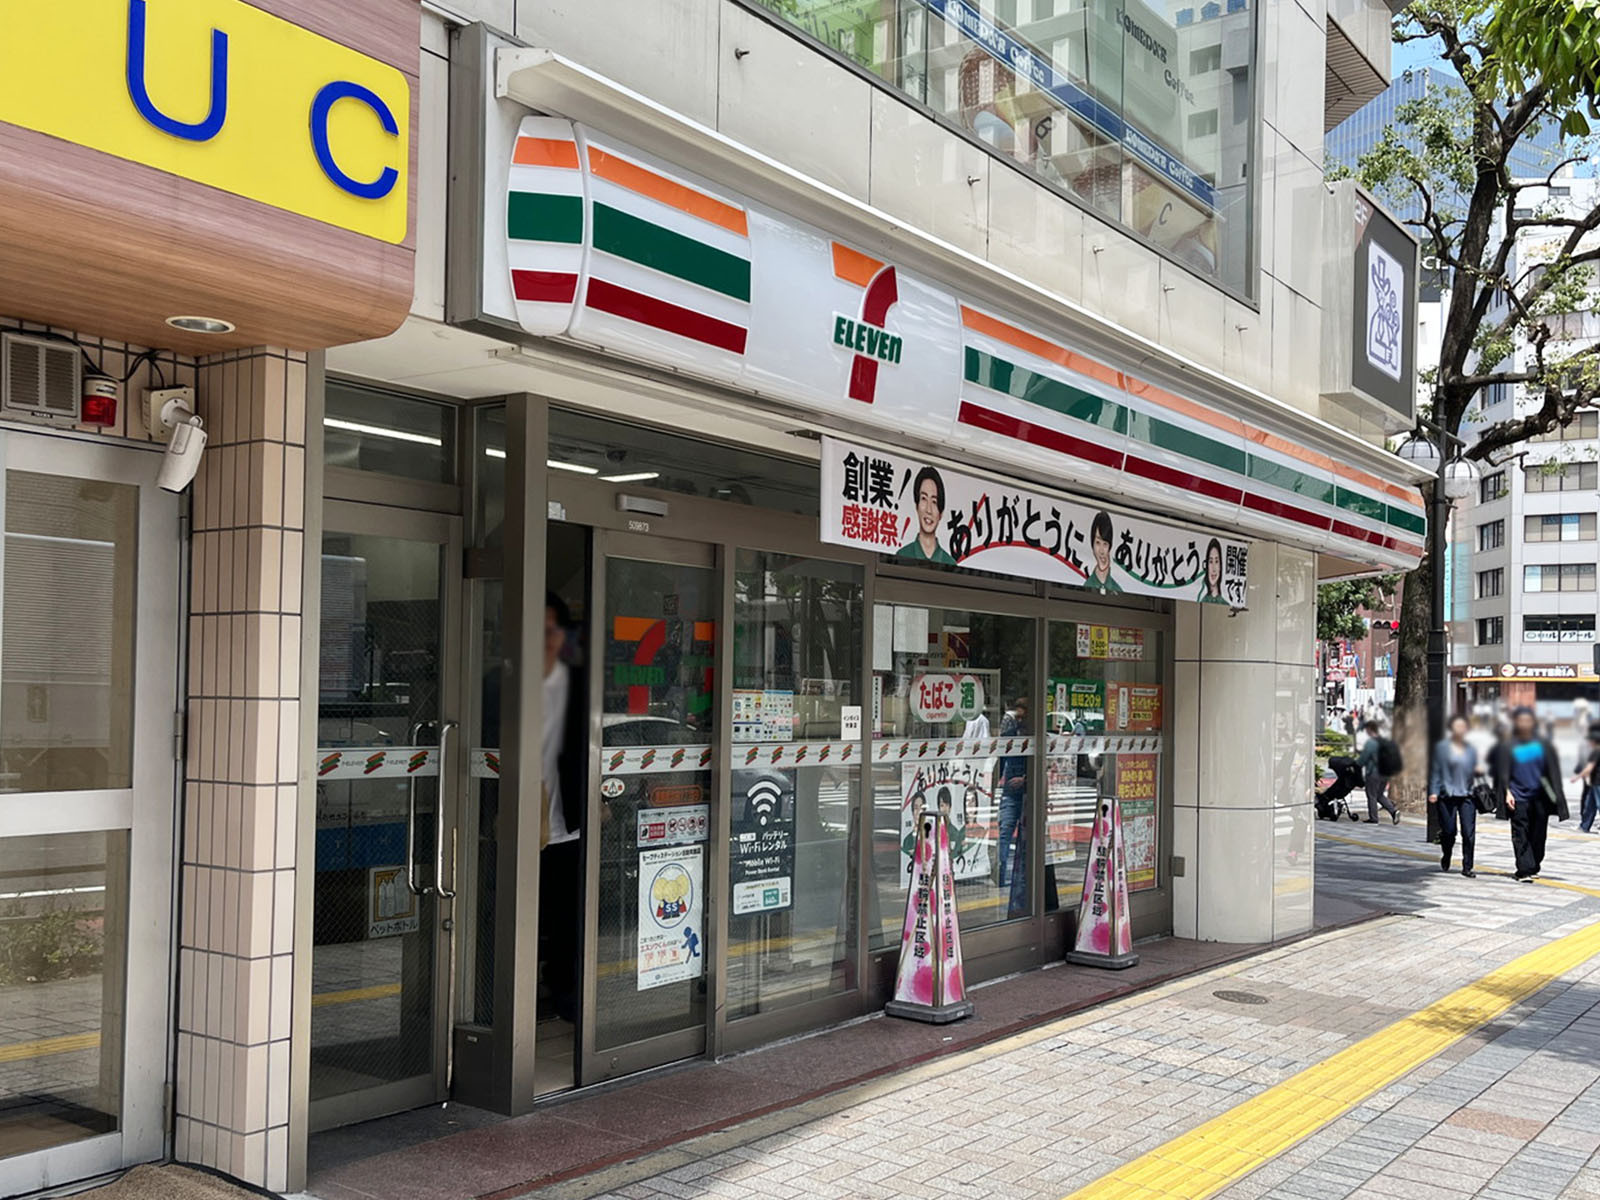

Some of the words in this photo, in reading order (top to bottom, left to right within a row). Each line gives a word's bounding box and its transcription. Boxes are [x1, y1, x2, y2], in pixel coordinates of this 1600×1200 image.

[1355, 199, 1368, 227] 2F
[1115, 528, 1201, 587] ありがとう
[1225, 545, 1248, 576] 開催
[919, 680, 955, 710] たばこ
[960, 682, 976, 710] 酒
[665, 903, 678, 913] SS
